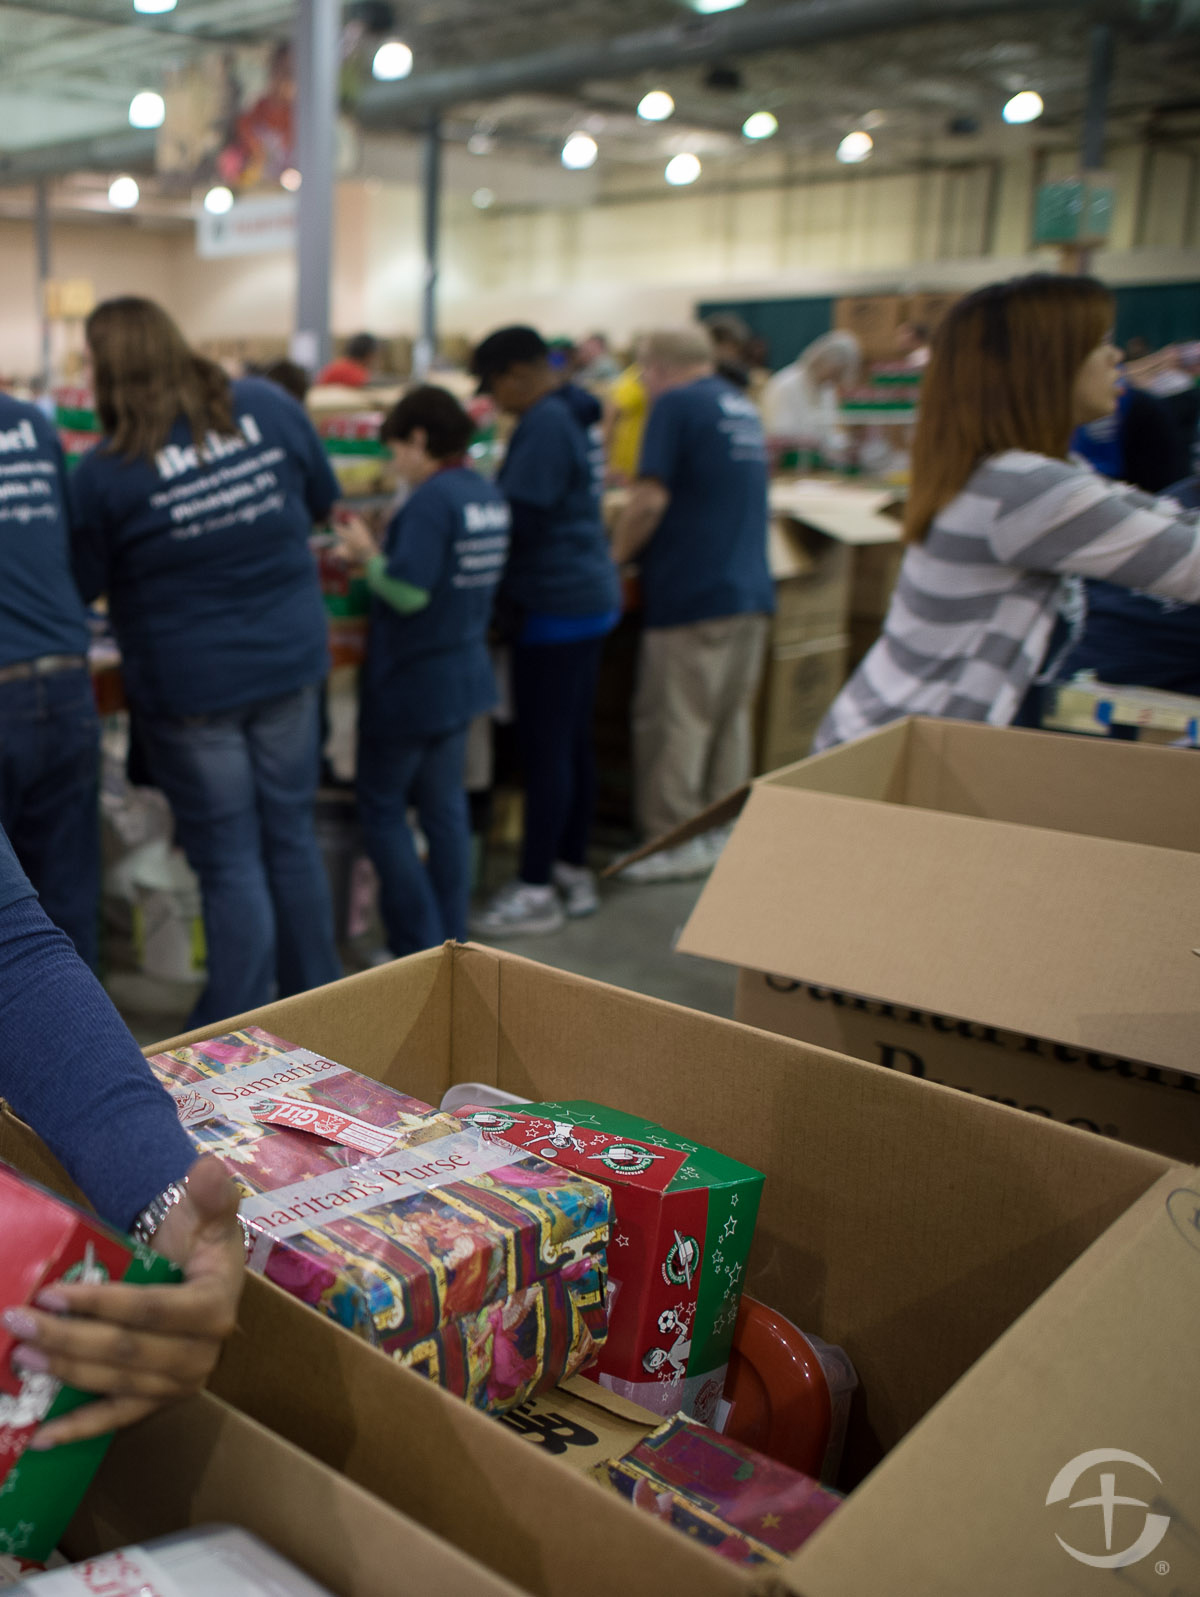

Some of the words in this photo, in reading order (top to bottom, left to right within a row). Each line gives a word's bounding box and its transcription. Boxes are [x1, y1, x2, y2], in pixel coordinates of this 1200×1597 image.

[211, 1056, 337, 1102] Samarita
[272, 1103, 320, 1127] Girl
[378, 1150, 471, 1187] Purse
